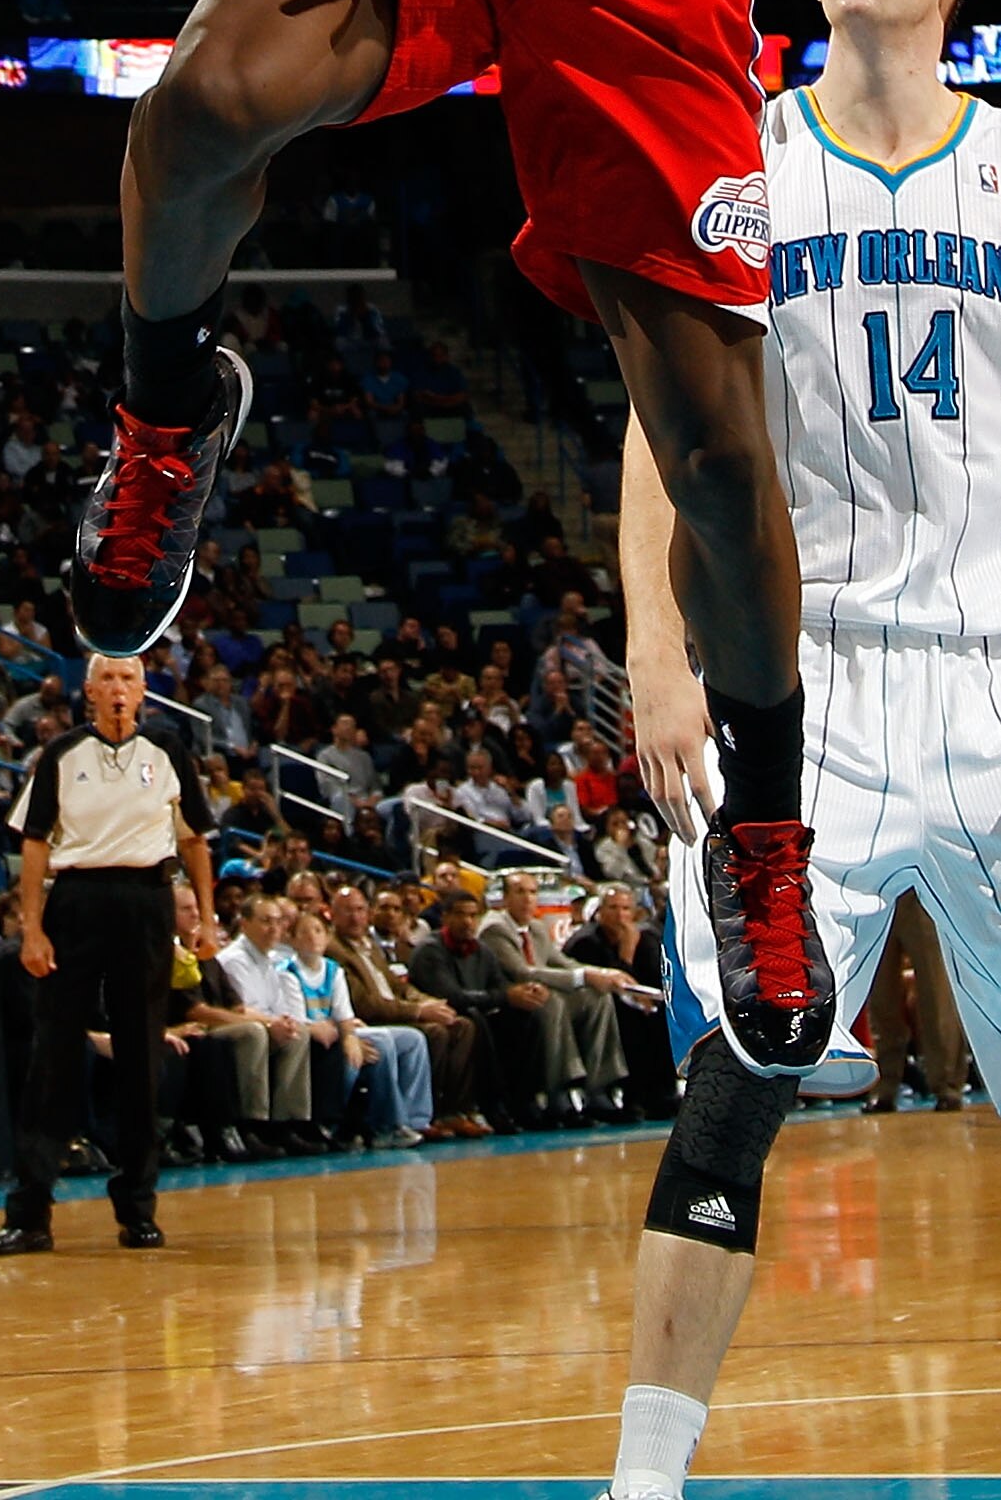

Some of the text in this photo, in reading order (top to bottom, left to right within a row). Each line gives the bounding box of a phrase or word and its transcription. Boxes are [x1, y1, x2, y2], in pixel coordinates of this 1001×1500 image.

[698, 200, 770, 246] CLIPPER
[770, 232, 848, 306] NEW
[862, 310, 960, 422] 14
